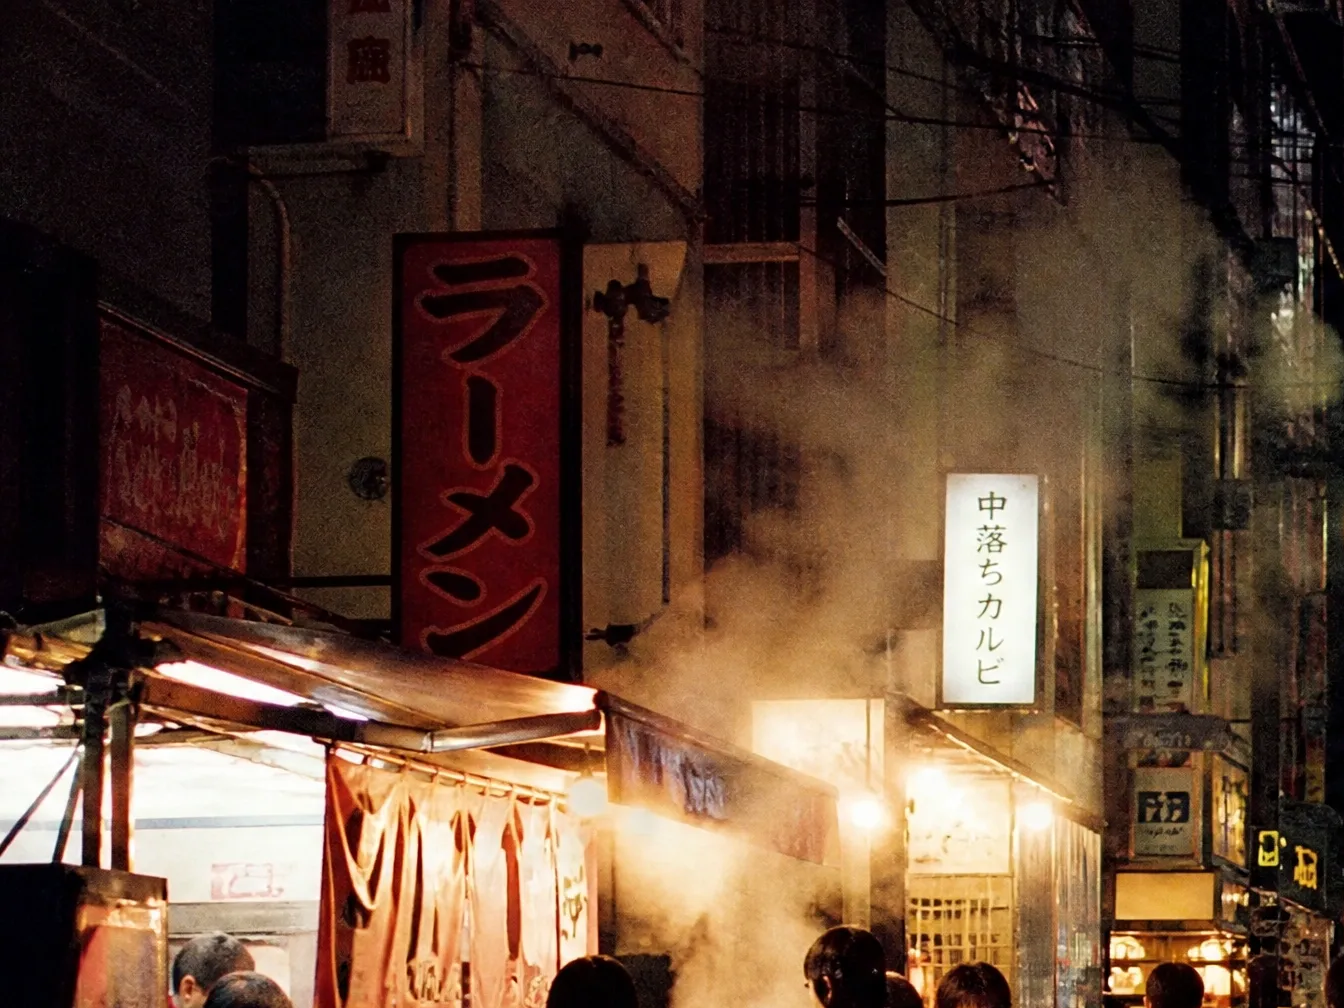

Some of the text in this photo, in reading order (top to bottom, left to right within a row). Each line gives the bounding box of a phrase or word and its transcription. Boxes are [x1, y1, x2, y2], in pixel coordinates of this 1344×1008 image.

[415, 253, 551, 662] ラーメン
[976, 491, 1008, 685] 中落ちカルビ
